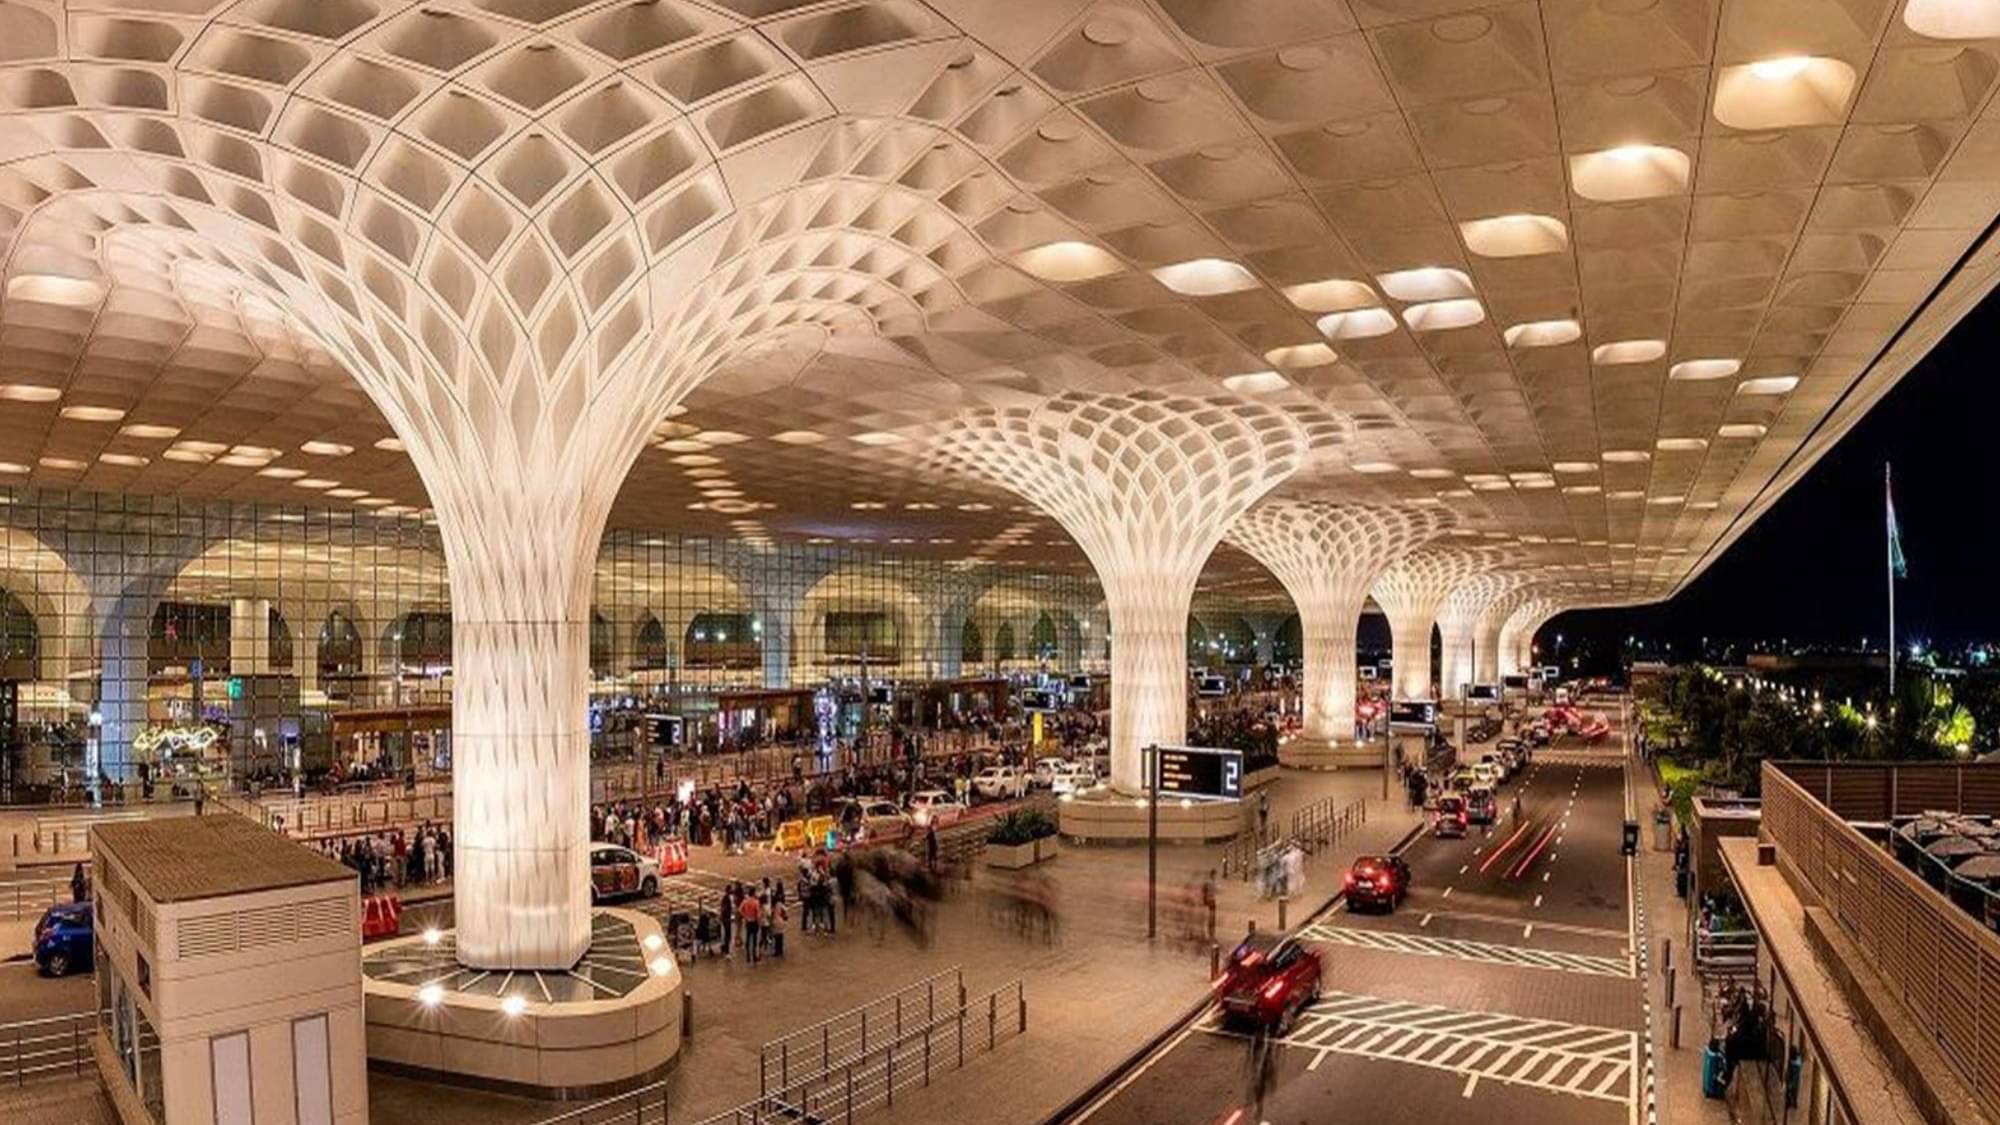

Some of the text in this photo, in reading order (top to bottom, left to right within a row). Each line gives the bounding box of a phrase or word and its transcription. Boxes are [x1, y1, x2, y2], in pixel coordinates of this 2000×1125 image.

[1425, 705, 1433, 722] 3
[671, 723, 680, 744] 2
[1226, 761, 1238, 790] 2
